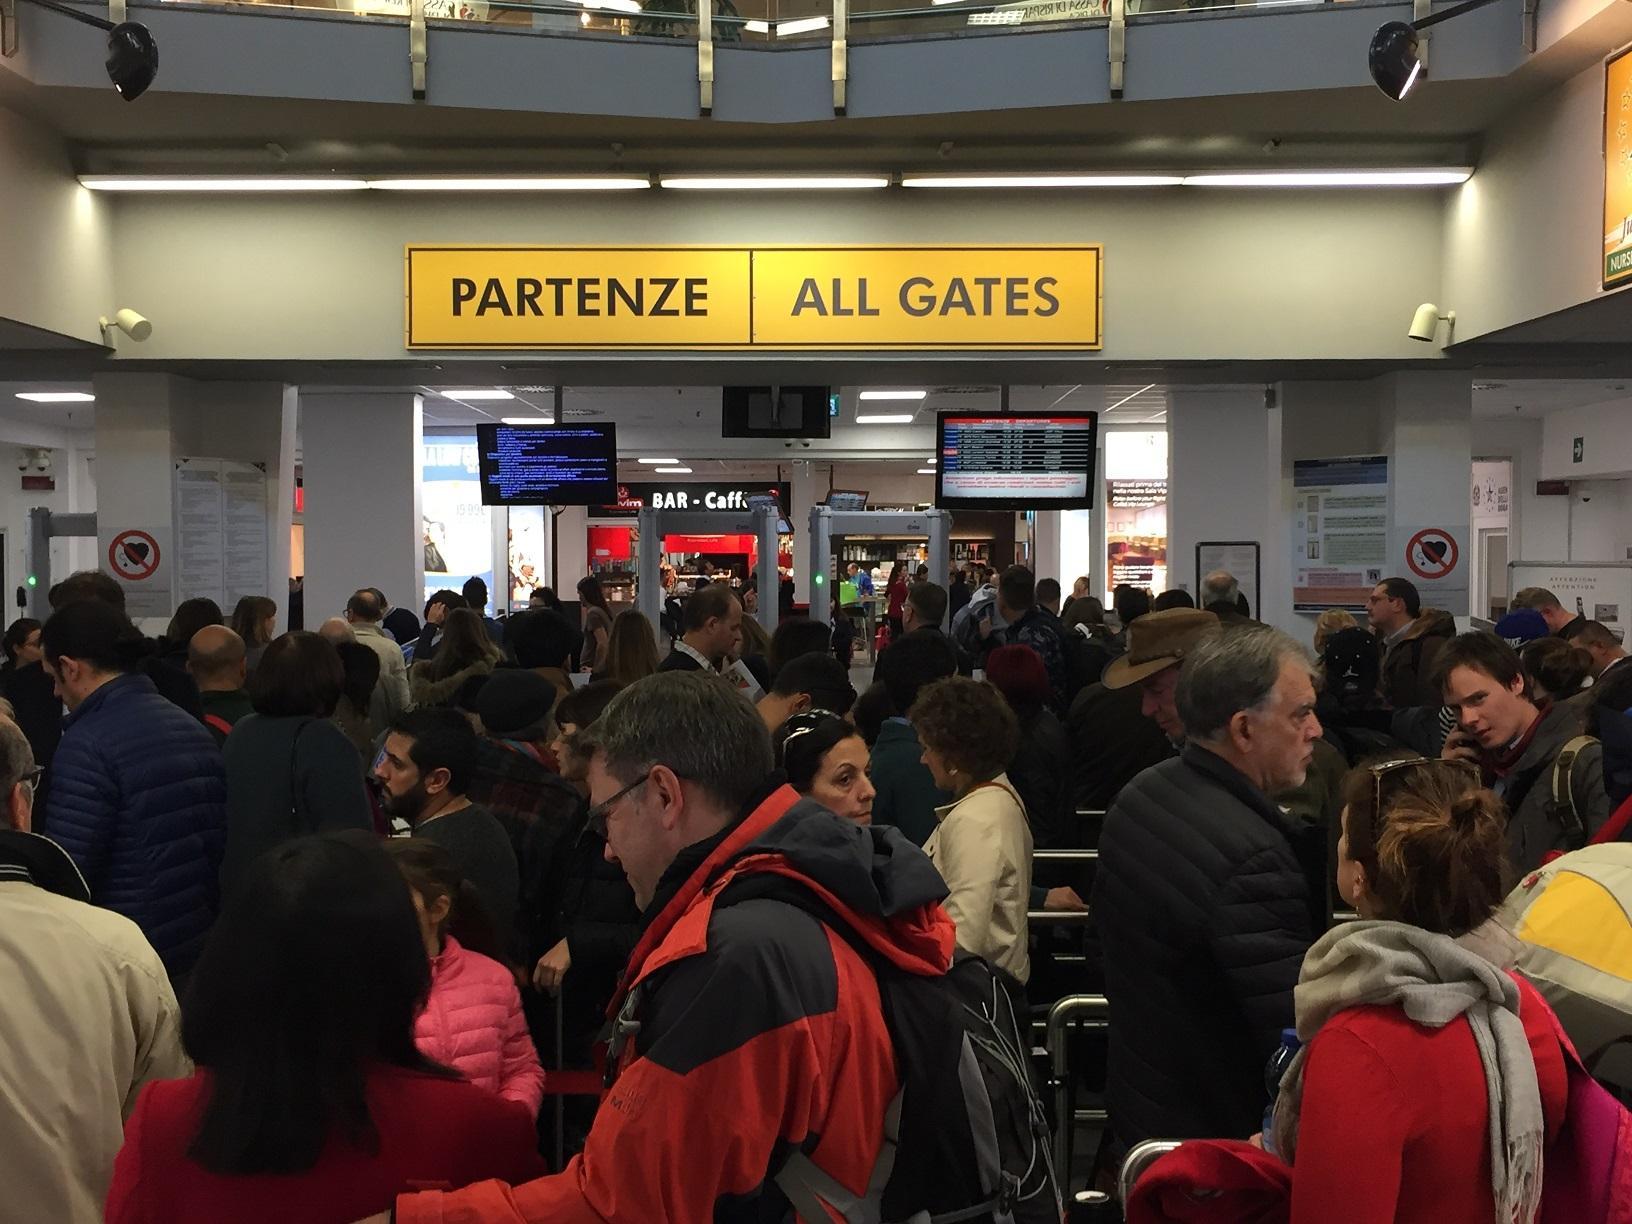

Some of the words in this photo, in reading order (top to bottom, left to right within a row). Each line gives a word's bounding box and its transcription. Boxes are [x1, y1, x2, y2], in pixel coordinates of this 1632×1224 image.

[1610, 251, 1632, 271] NURS
[453, 279, 707, 316] PARTENZE
[792, 279, 879, 315] ALL
[900, 278, 1058, 316] GATES
[618, 498, 642, 507] vim
[652, 492, 688, 509] BAR
